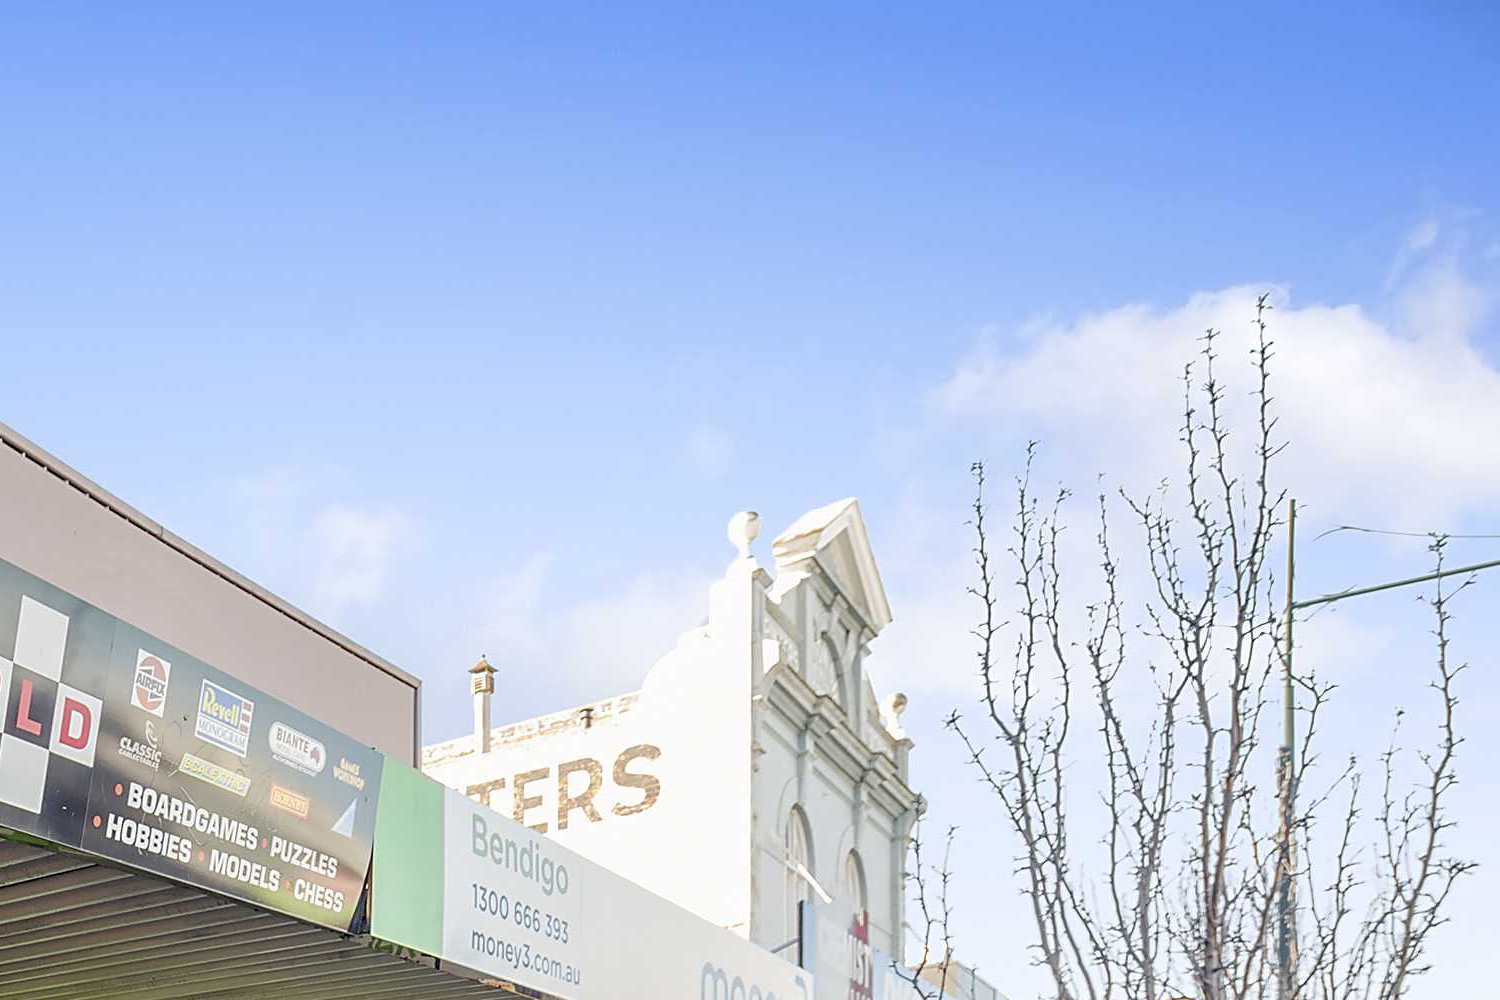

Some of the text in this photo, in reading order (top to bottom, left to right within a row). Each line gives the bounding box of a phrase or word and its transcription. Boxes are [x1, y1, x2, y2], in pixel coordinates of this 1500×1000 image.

[135, 671, 166, 697] AIRFIX
[202, 687, 240, 727] Revell
[120, 737, 161, 762] CLASSIC
[197, 718, 247, 749] MONOGRAM
[276, 727, 309, 753] BIANTE
[183, 757, 246, 791] SCALEXTRIC
[333, 766, 365, 791] WORKSHOP
[273, 790, 307, 813] HORNBY
[127, 781, 338, 879] BOARDGAMES PUZZLES
[106, 813, 344, 913] HOBBIES MODELS CHESS
[471, 813, 569, 896] Bendigo
[472, 883, 569, 944] 1300 666 393
[471, 928, 581, 987] money3.com.au
